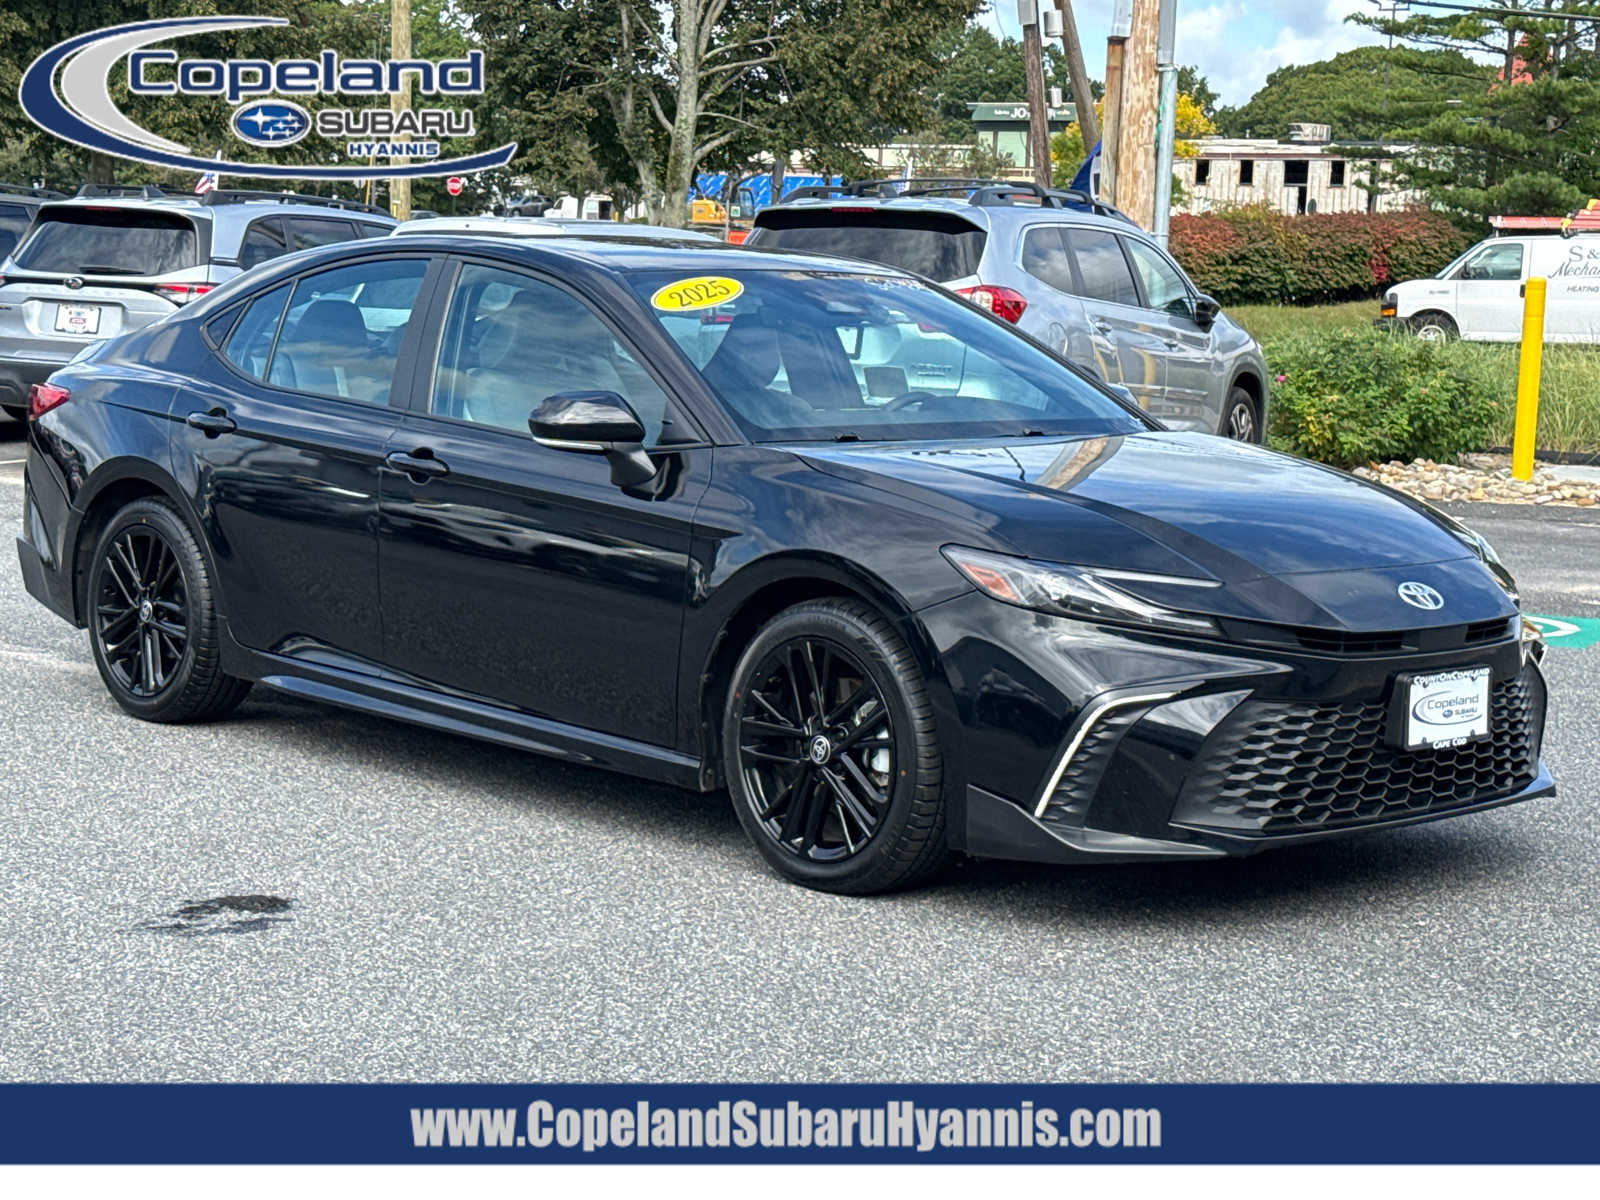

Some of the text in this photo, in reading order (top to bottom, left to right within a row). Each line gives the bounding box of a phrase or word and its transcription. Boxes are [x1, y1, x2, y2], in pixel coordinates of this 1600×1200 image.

[1569, 245, 1583, 262] S
[668, 280, 731, 307] 2025
[1427, 694, 1479, 710] Copeland
